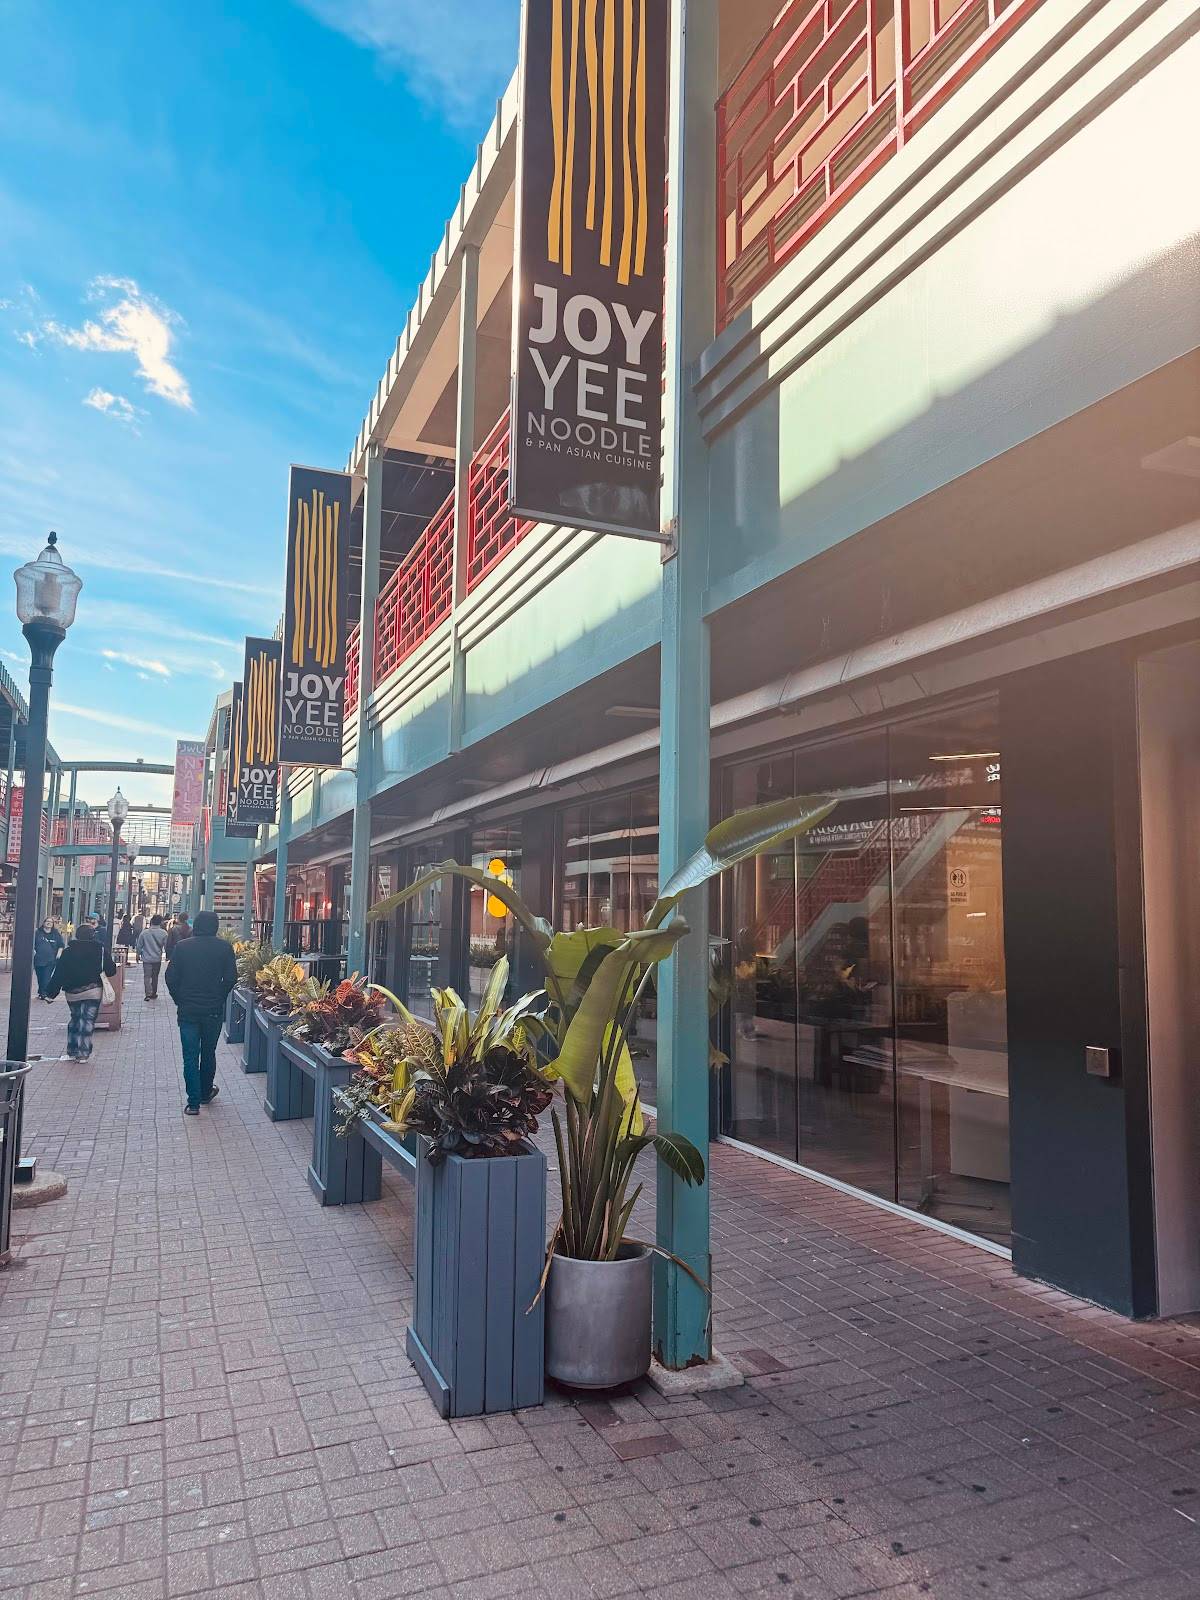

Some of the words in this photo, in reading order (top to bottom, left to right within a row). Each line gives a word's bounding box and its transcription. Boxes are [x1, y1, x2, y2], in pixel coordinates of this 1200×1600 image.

[528, 283, 657, 365] JOY
[528, 347, 648, 430] YEE
[527, 411, 652, 458] NOODLE
[525, 438, 533, 447] &
[538, 440, 561, 453] PAN
[566, 447, 601, 460] ASIAN
[605, 454, 652, 471] CUISINE
[284, 672, 344, 701] JOY
[285, 698, 339, 727] YEE
[283, 724, 340, 738] NOODLE
[182, 757, 197, 815] NAILS
[240, 767, 277, 785] JOY
[228, 791, 237, 805] J
[239, 798, 275, 807] NOODLE
[240, 783, 274, 800] YEE
[228, 804, 238, 818] Y
